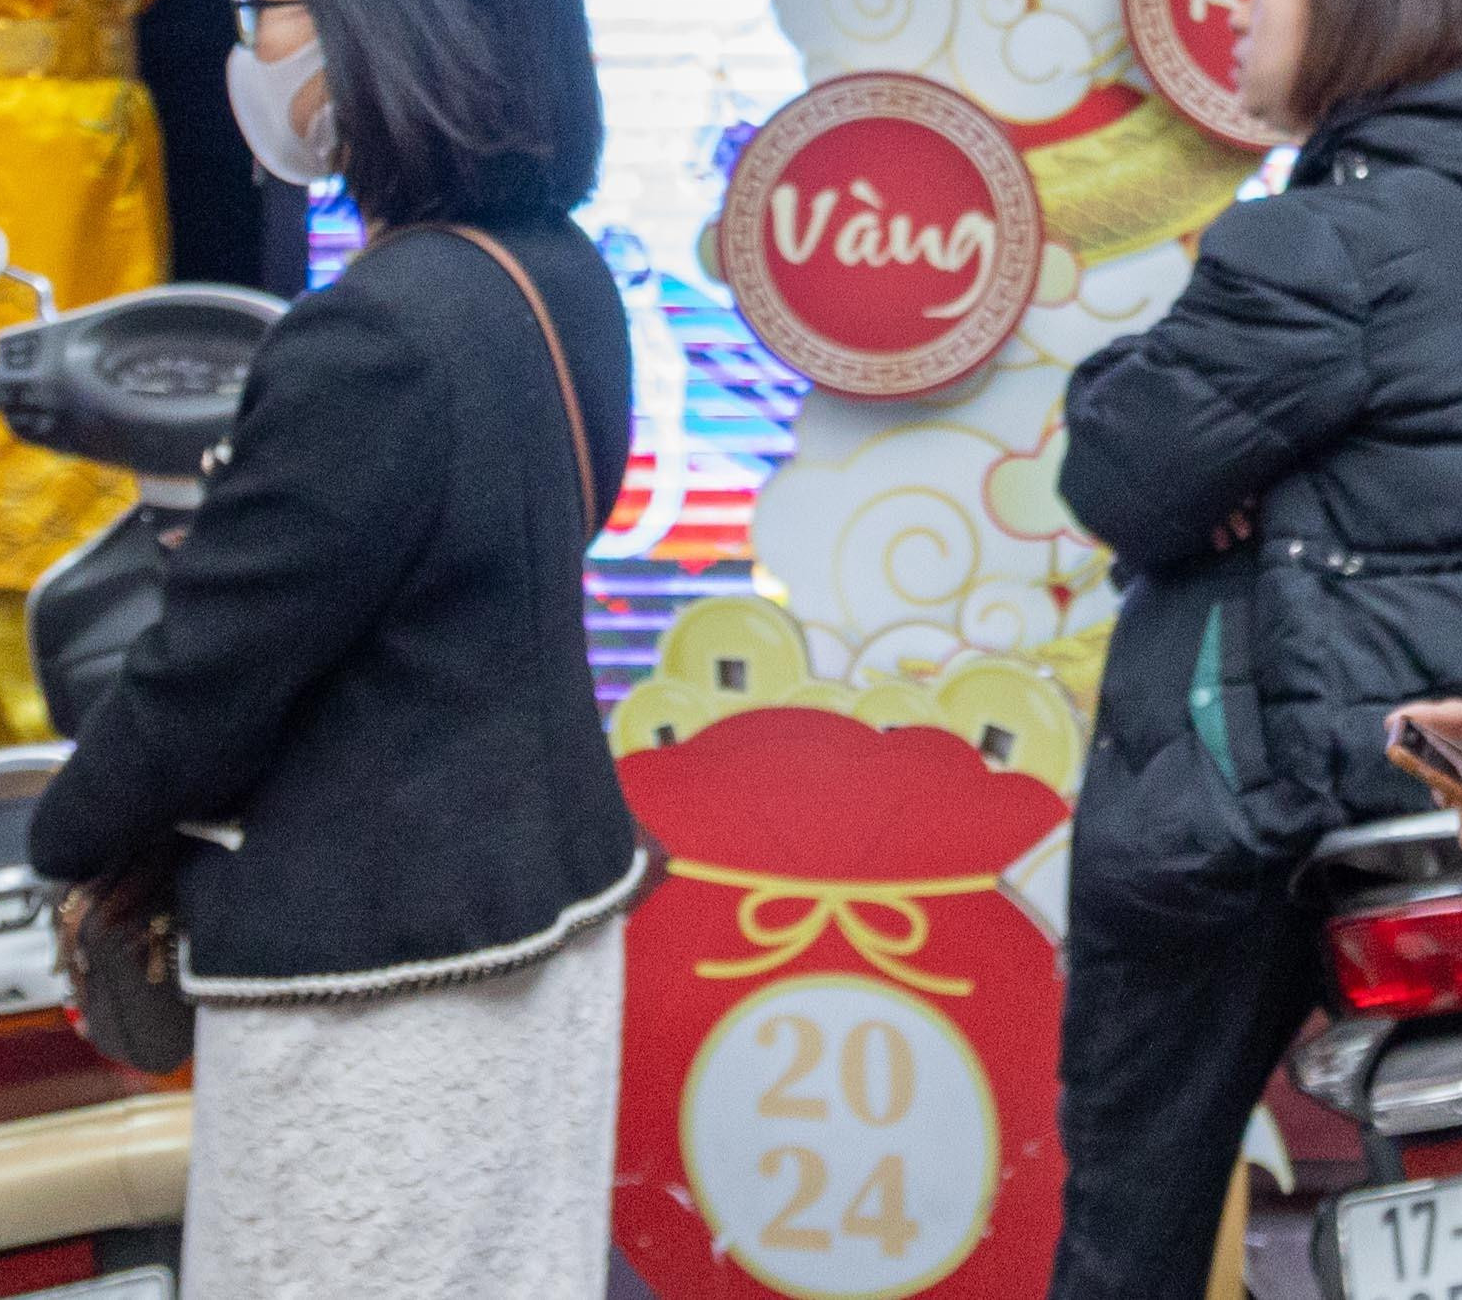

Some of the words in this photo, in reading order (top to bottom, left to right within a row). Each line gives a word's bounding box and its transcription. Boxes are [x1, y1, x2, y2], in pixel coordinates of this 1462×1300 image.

[771, 180, 1001, 318] Vàng
[755, 1014, 917, 1126] 20
[756, 1144, 920, 1258] 24
